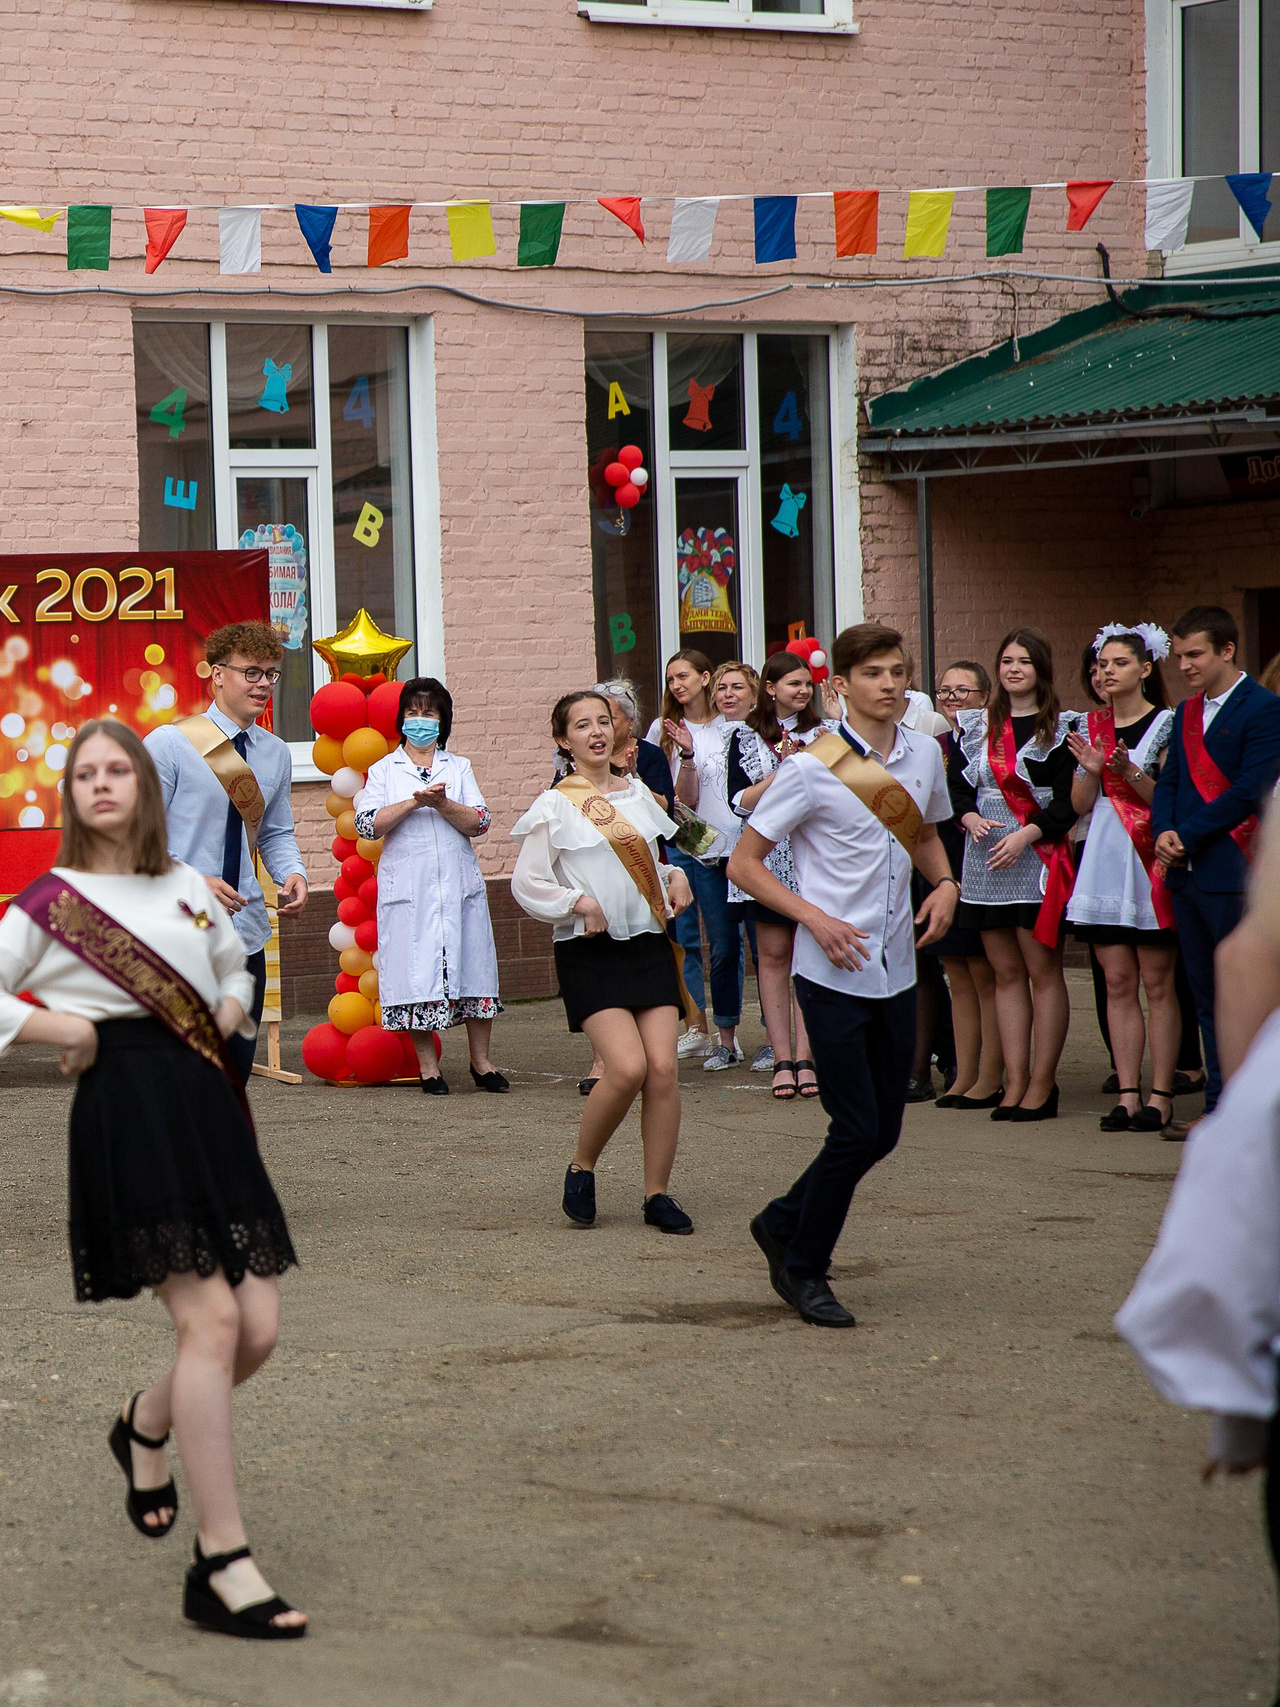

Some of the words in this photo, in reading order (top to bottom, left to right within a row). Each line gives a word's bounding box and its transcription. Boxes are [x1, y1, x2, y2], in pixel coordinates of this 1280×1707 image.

[149, 385, 189, 439] 4
[343, 376, 376, 428] 4
[773, 391, 803, 441] 4
[36, 567, 184, 622] 2021
